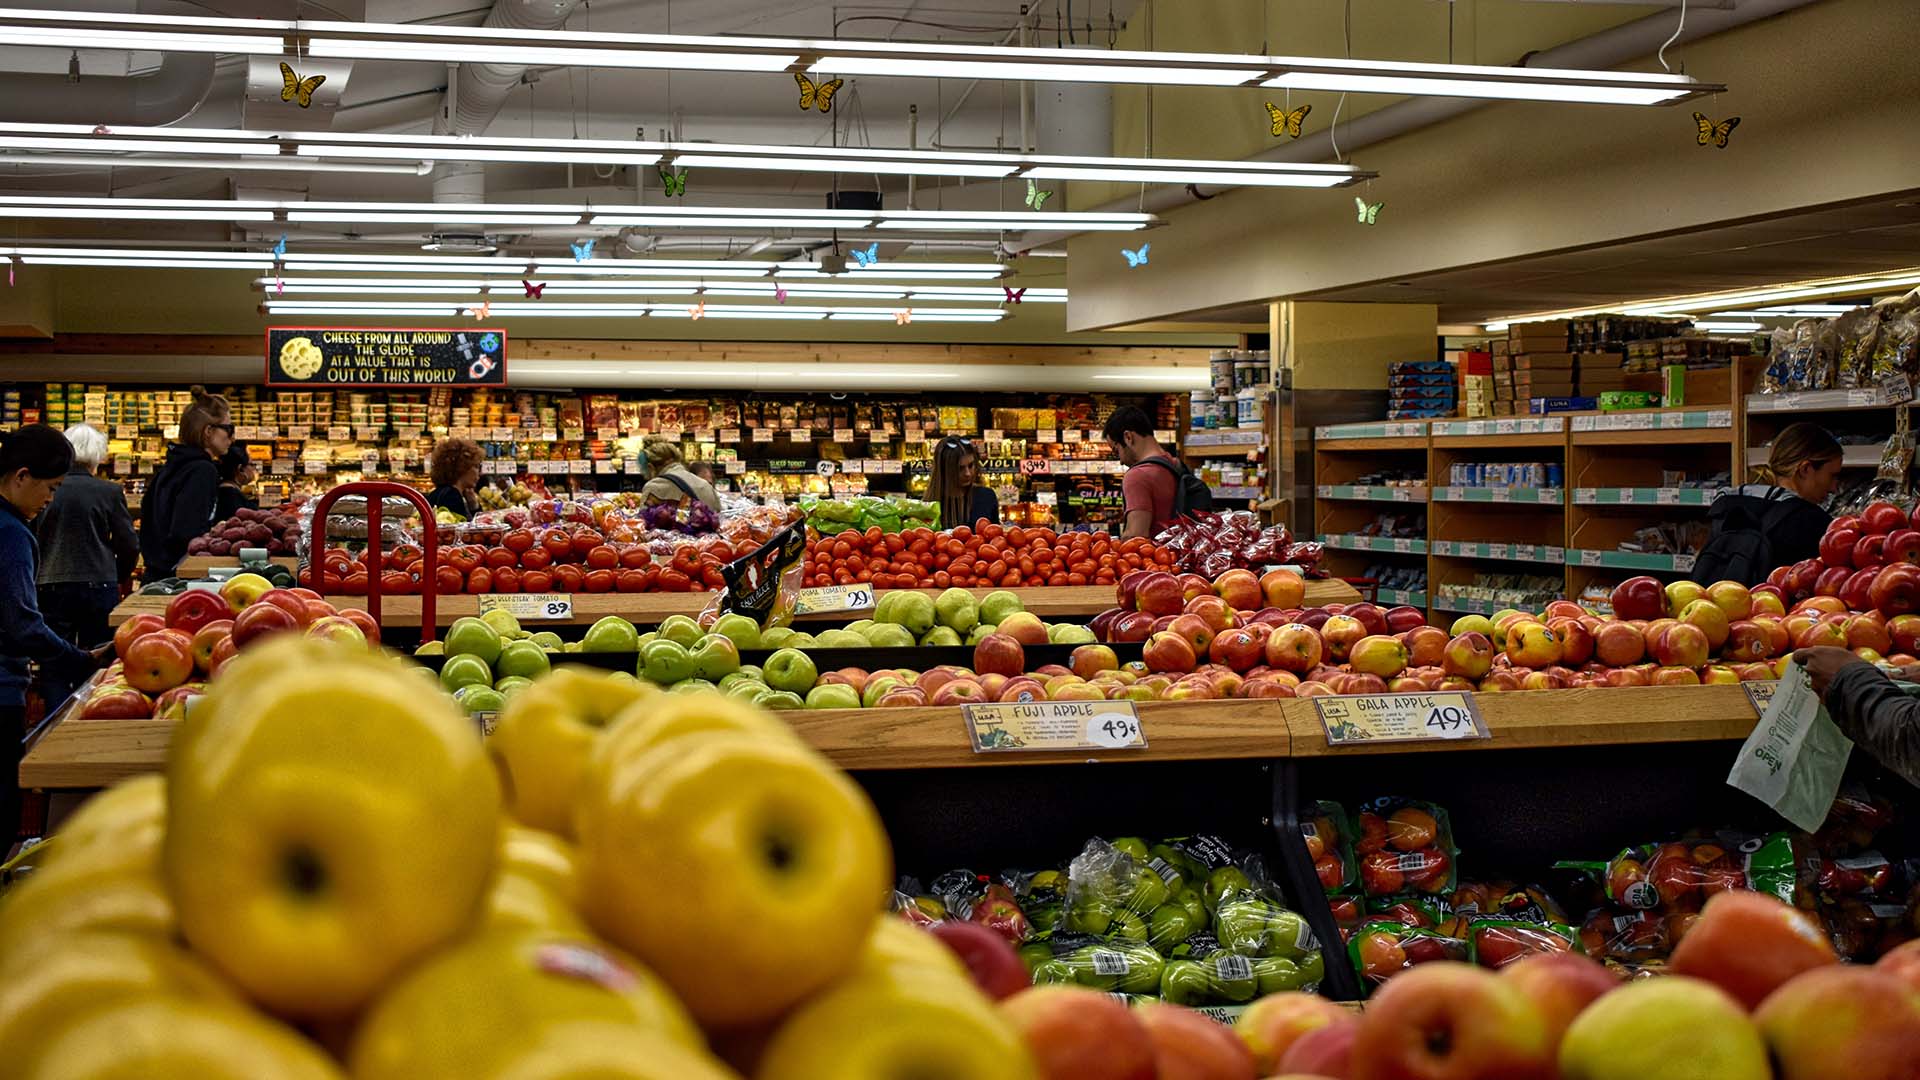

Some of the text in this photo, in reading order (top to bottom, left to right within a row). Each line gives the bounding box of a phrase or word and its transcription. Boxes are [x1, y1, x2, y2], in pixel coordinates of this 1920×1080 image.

[323, 332, 451, 344] CHEESE FROM ALL AROUND
[356, 345, 414, 356] THE GLOBE
[331, 356, 431, 367] AT A VALUE THAT IS
[328, 369, 456, 382] OUT OF THIS WORLD
[822, 586, 847, 594] TOMATO
[1356, 696, 1436, 711] GALA APPLE
[1014, 704, 1093, 718] FUJI APPLE
[1426, 707, 1472, 730] 49¢
[1102, 720, 1136, 740] 49¢
[1754, 748, 1782, 771] OPEN
[1194, 842, 1217, 862] Apples
